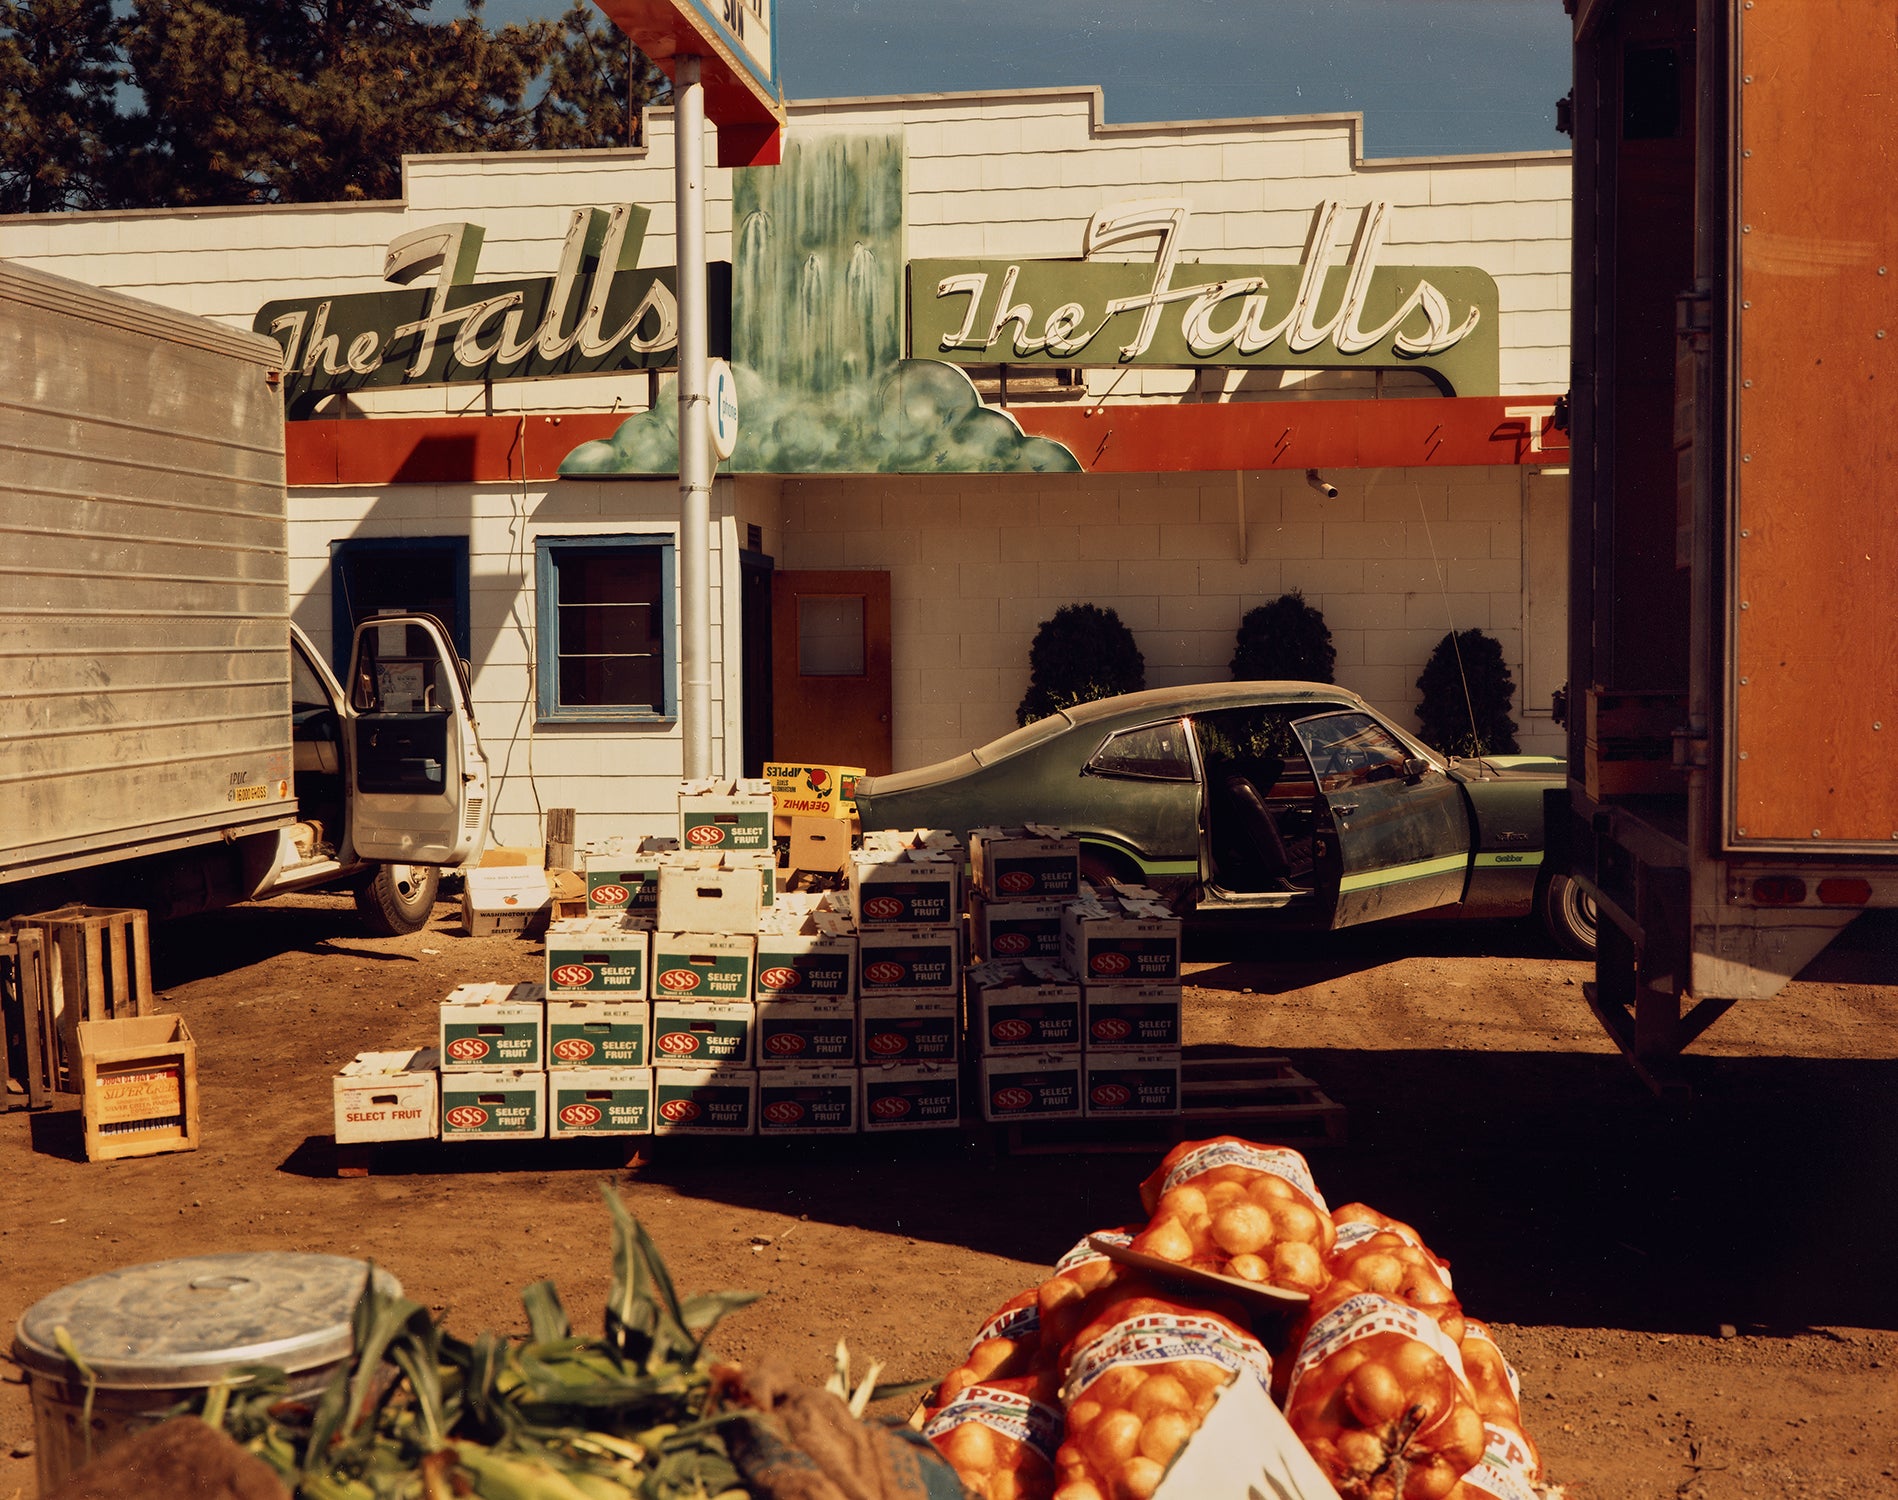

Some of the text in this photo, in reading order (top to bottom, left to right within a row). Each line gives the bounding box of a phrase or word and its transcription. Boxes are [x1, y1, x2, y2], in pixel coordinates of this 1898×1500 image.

[938, 198, 1480, 362] The Falls
[270, 203, 678, 378] The Falls
[692, 826, 719, 841] SSS
[731, 828, 763, 836] SELECT
[1004, 873, 1030, 888] SSS
[1041, 872, 1072, 880] SELECT
[1045, 881, 1068, 889] FRUIT
[595, 886, 624, 901] SSS
[871, 899, 898, 914] SSS
[1000, 935, 1025, 950] SSS
[1037, 935, 1059, 943] SELE
[1097, 953, 1124, 969] SSS
[1138, 955, 1170, 963] SELECT
[601, 967, 636, 975] SELECT
[871, 963, 899, 979] SSS
[912, 963, 945, 971] SELECT
[1141, 964, 1166, 972] FRUIT
[558, 966, 586, 982] SSS
[665, 971, 694, 986] SSS
[708, 973, 742, 981] SELECT
[766, 969, 794, 984] SSS
[809, 971, 842, 979] SELECT
[812, 980, 837, 988] FRUIT
[999, 1020, 1026, 1036] SSS
[1040, 1020, 1072, 1028] SELECT
[1099, 1020, 1126, 1036] SSS
[1139, 1020, 1171, 1028] SELECT
[1043, 1029, 1068, 1037] FRUIT
[1142, 1029, 1166, 1037] FRUIT
[497, 1040, 532, 1048] SELECT
[664, 1033, 693, 1049] SSS
[706, 1037, 740, 1045] SELECT
[772, 1035, 800, 1050] SSS
[875, 1034, 902, 1049] SSS
[454, 1040, 482, 1055] SSS
[560, 1040, 588, 1056] SSS
[710, 1046, 735, 1054] FRUIT
[817, 1045, 842, 1053] FRUIT
[918, 1044, 944, 1052] FRUIT
[1000, 1087, 1026, 1103] SSS
[1040, 1087, 1072, 1096] SELECT
[1097, 1085, 1124, 1101] SSS
[1138, 1086, 1170, 1095] SELECT
[917, 1097, 951, 1105] SELECT
[1043, 1097, 1069, 1105] FRUIT
[1141, 1095, 1166, 1103] FRUIT
[665, 1101, 694, 1117] SSS
[770, 1103, 798, 1118] SSS
[877, 1098, 904, 1114] SSS
[921, 1106, 947, 1114] FRUIT
[346, 1109, 422, 1122] SELECT FRUIT
[453, 1107, 481, 1123] SSS
[495, 1108, 531, 1116] SELECT
[566, 1105, 595, 1121] SSS
[499, 1117, 526, 1125] FRUIT
[612, 1116, 639, 1124] FRUIT
